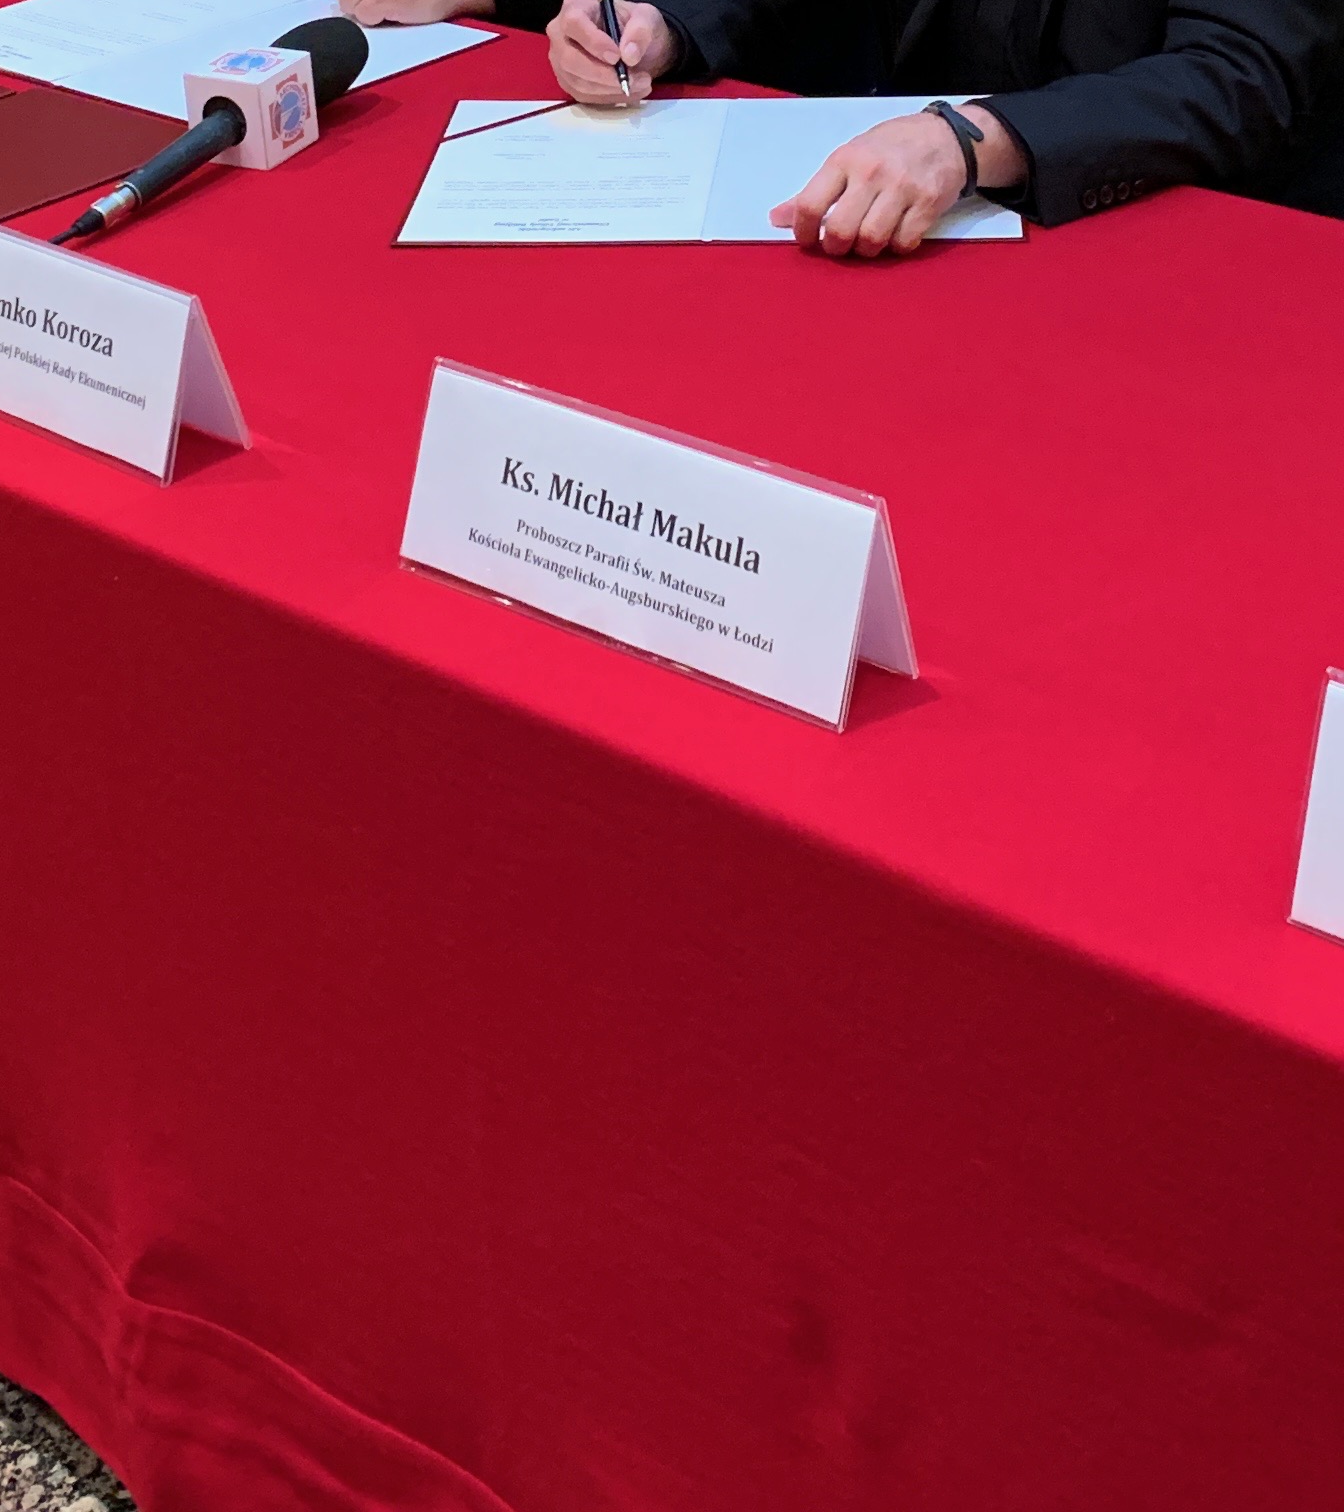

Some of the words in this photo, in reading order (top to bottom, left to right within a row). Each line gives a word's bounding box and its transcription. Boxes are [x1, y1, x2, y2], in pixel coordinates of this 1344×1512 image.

[42, 308, 114, 357] Koroza
[13, 346, 51, 374] Polskiej
[52, 361, 78, 383] Rady
[78, 371, 146, 410] Ekumenicznej
[501, 457, 539, 496] Ks.
[548, 473, 643, 532] Michał
[649, 508, 761, 575] Makula
[468, 527, 522, 559] Kościoła
[524, 548, 715, 632] Ewangelicko-Augsburskiego
[718, 622, 731, 636] w
[734, 625, 774, 653] Łodzi
[516, 518, 583, 556] Proboszcz
[584, 543, 630, 572] Parafii
[632, 557, 656, 583] Św.
[659, 571, 726, 608] Mateusza
